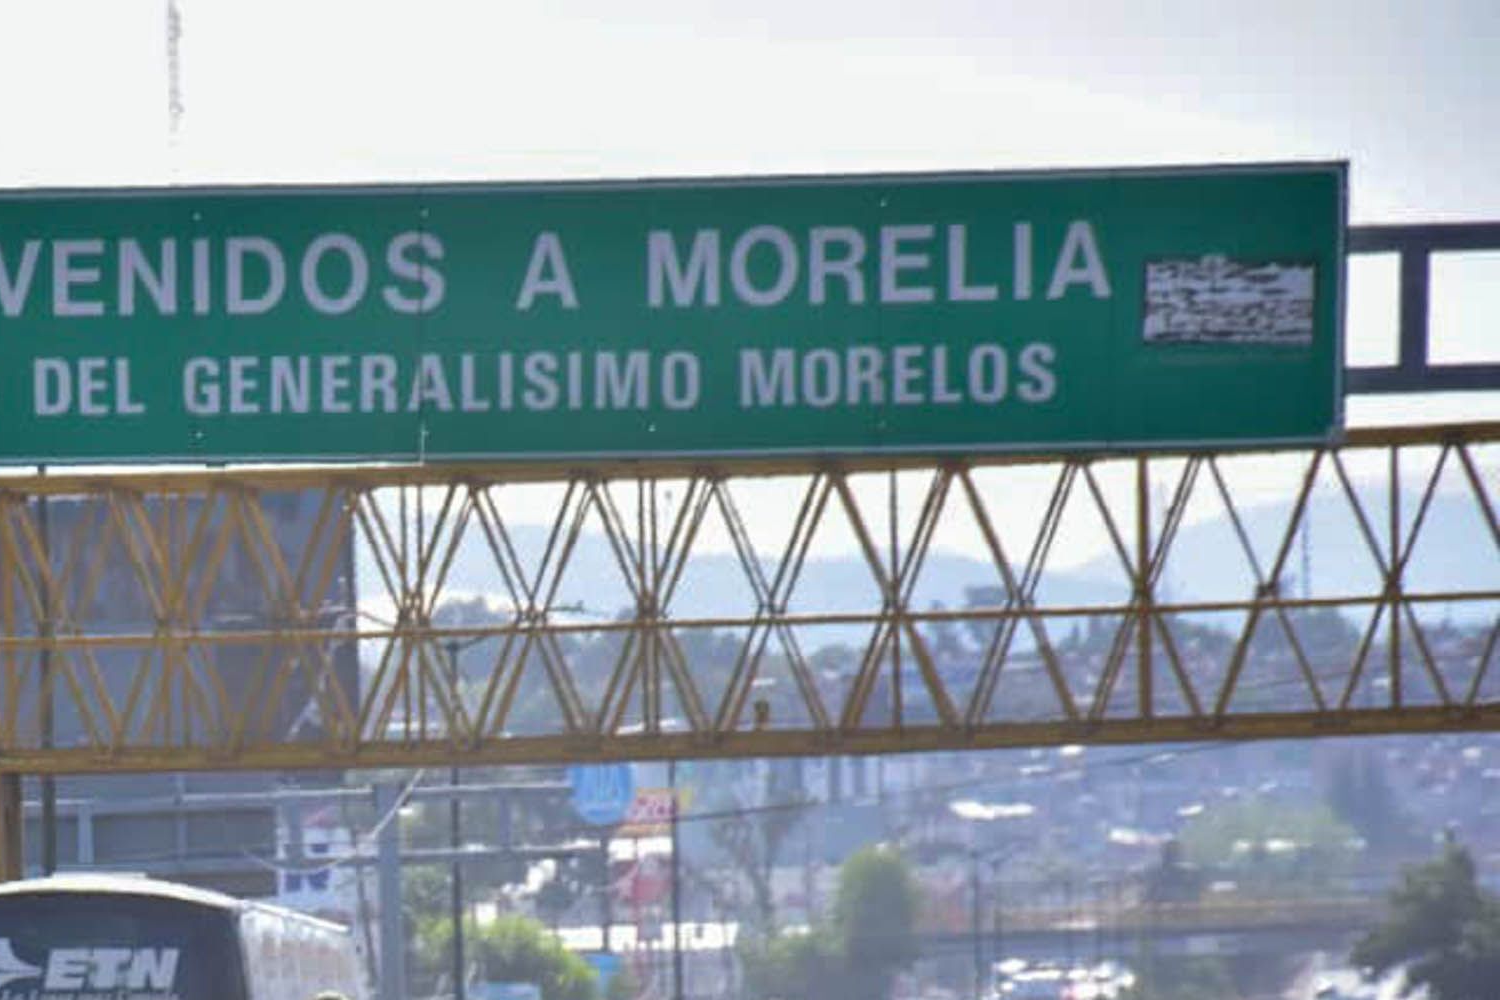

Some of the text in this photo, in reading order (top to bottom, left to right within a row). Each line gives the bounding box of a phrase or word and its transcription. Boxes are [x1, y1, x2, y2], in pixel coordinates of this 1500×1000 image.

[515, 231, 579, 311] A
[647, 221, 1111, 309] MORELIA
[33, 356, 146, 416] DEL
[183, 349, 701, 417] GENERALISIMO
[739, 343, 1056, 408] MORELOS
[44, 948, 179, 990] ETN
